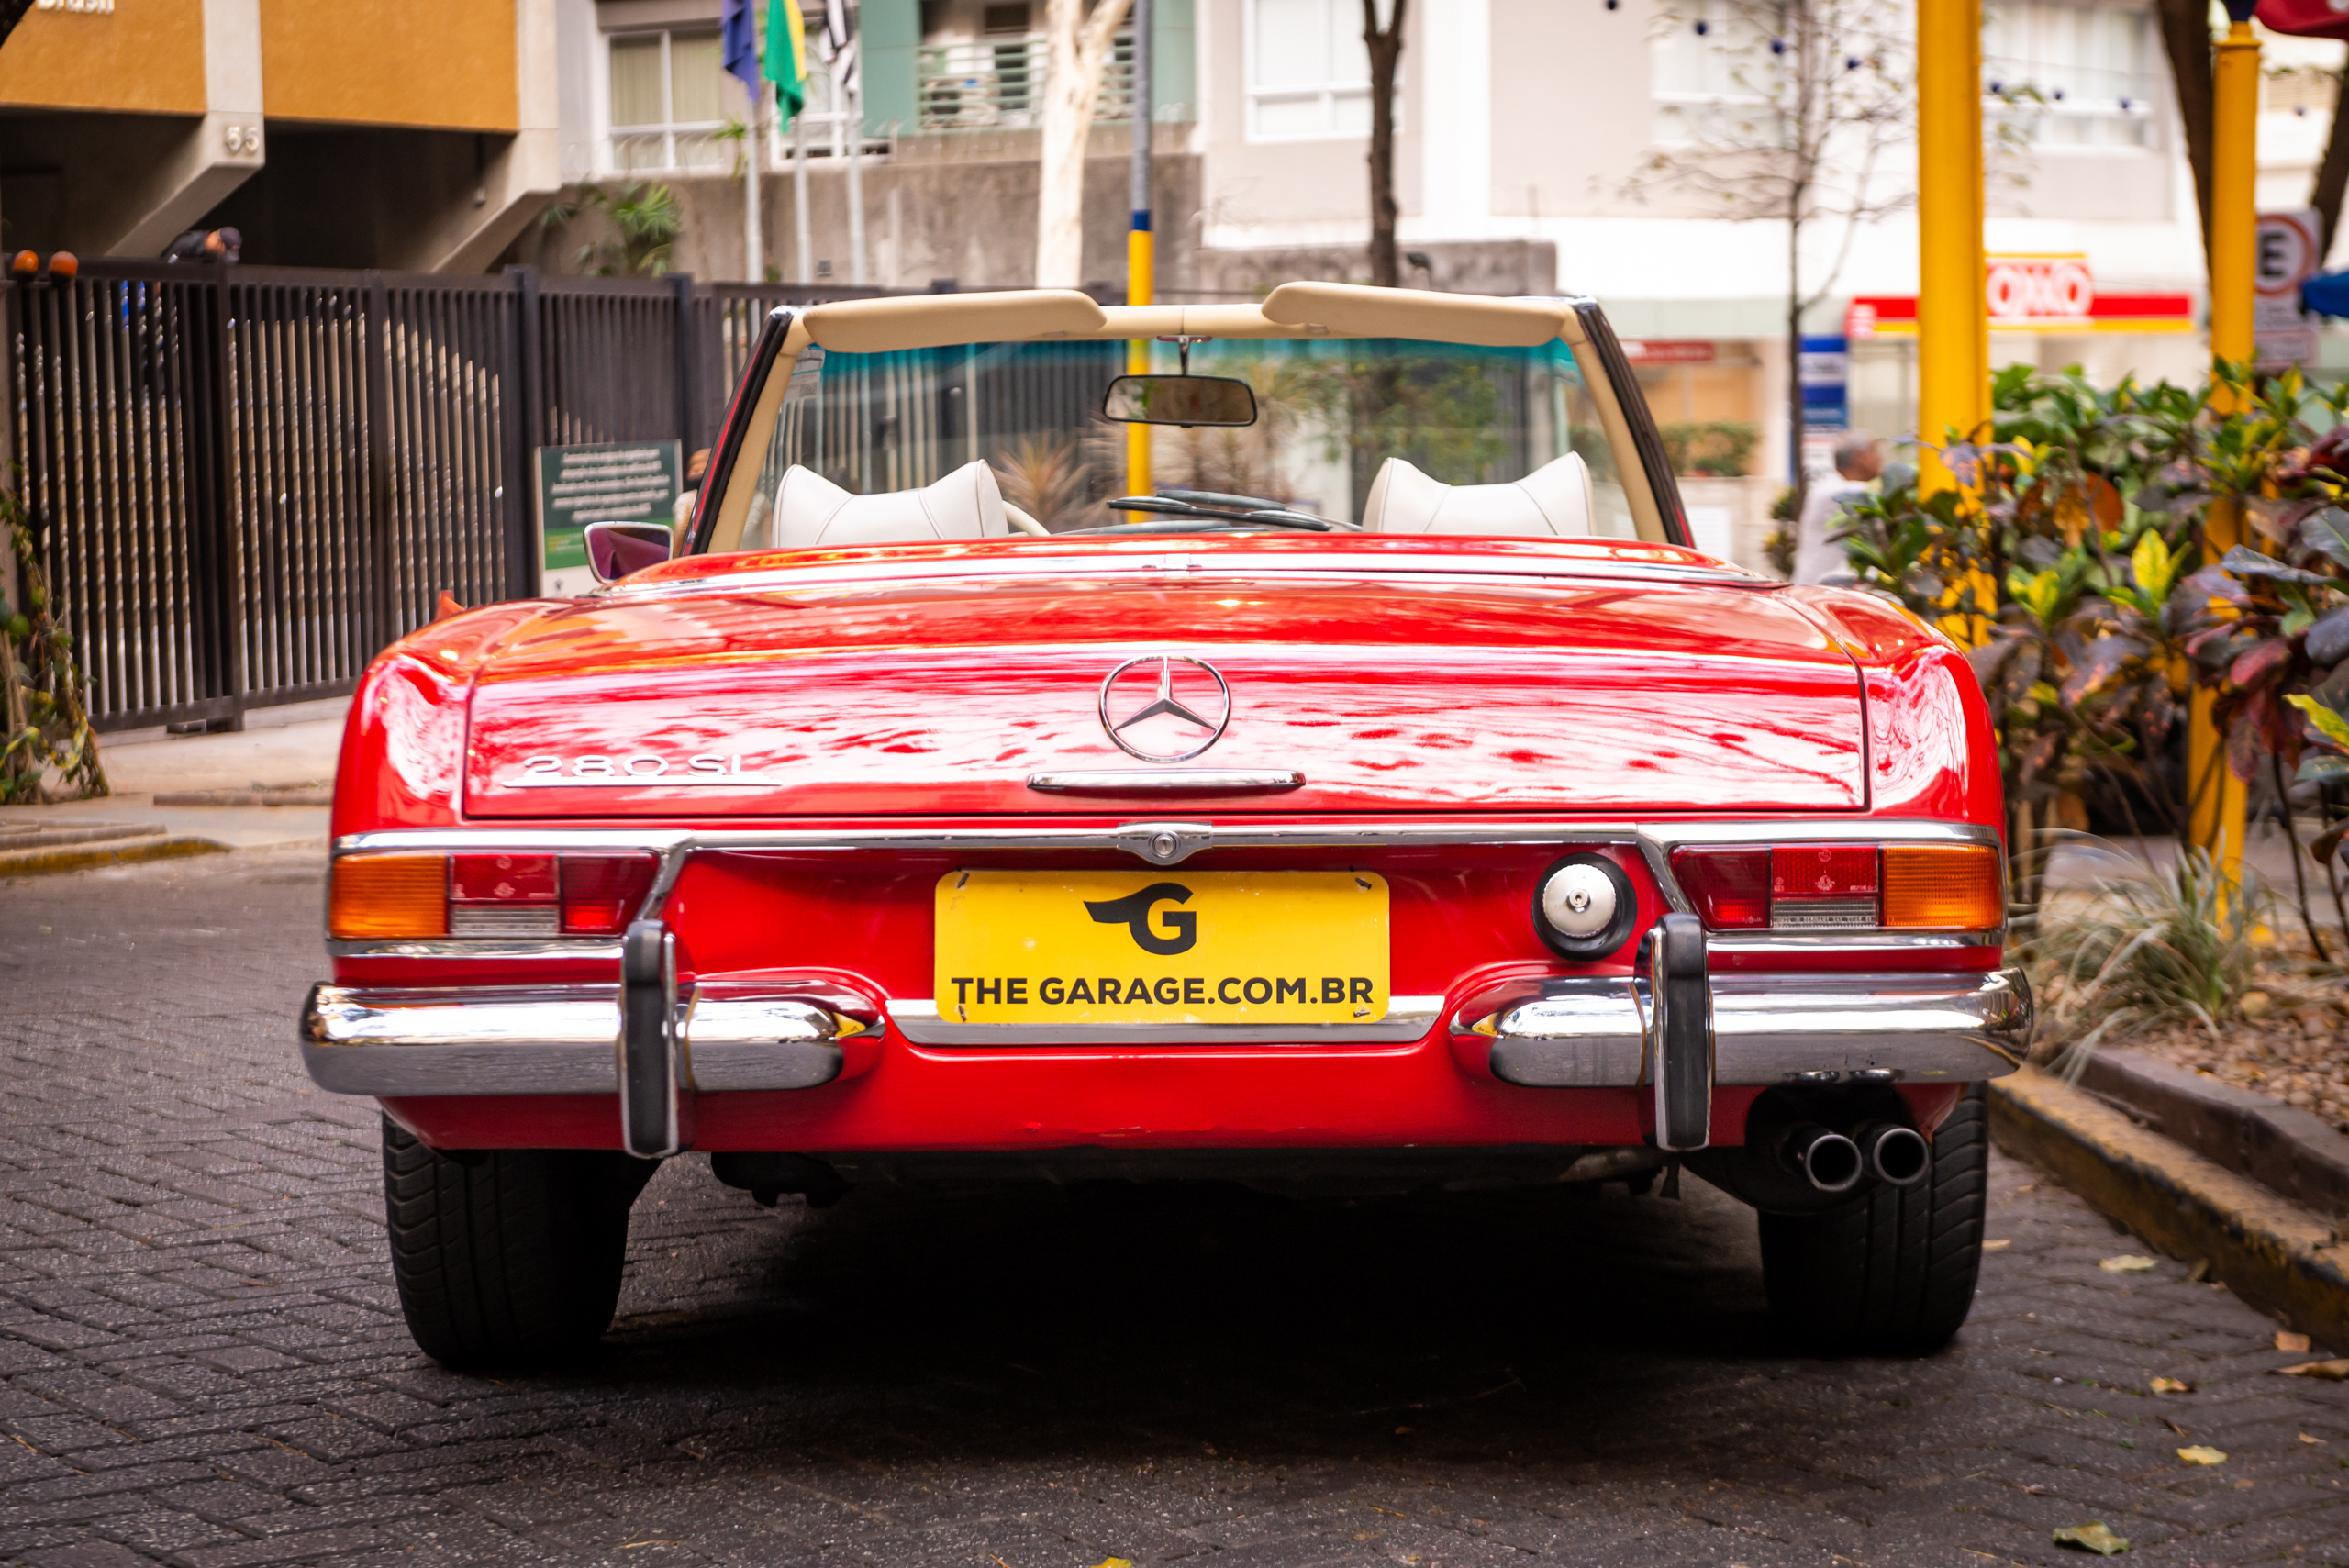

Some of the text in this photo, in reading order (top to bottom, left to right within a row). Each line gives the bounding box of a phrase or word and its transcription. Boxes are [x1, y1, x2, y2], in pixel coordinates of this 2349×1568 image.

[2260, 232, 2288, 277] E
[522, 754, 765, 778] 280 SL
[1083, 882, 1197, 955] G
[951, 976, 1375, 1006] THE GARAGE.COM.BR
